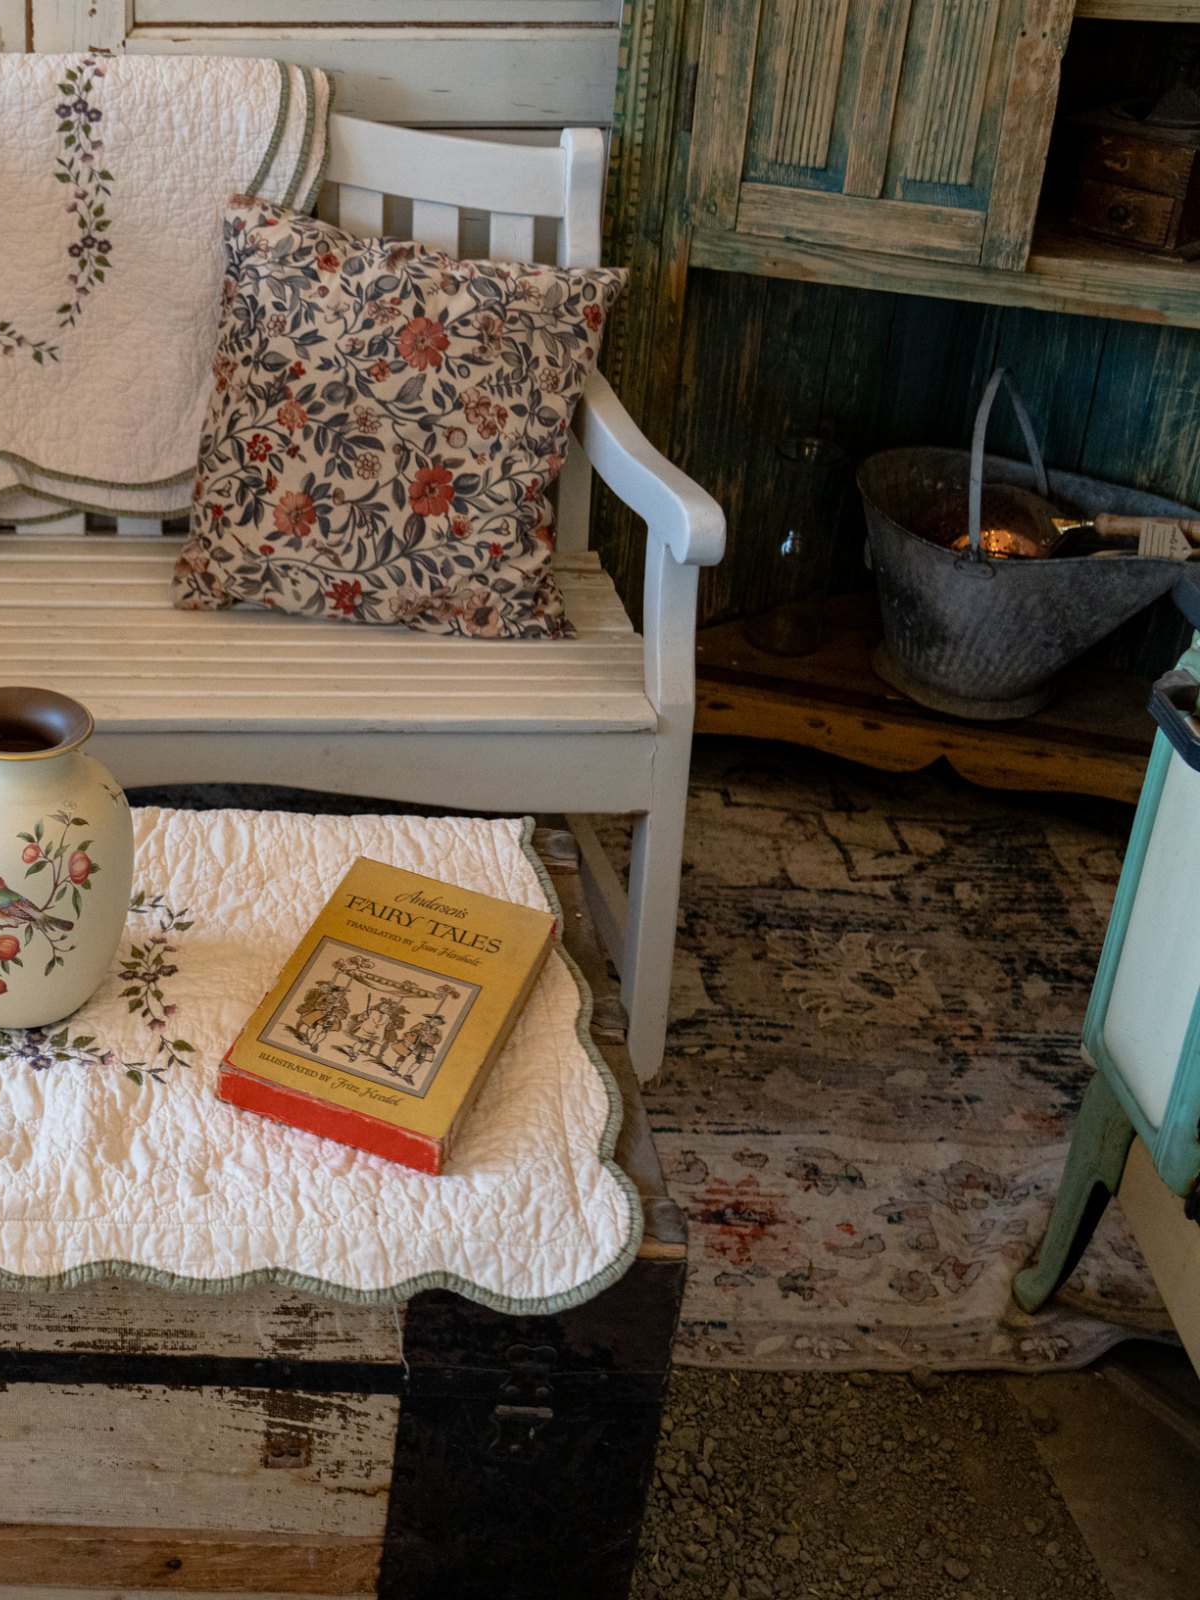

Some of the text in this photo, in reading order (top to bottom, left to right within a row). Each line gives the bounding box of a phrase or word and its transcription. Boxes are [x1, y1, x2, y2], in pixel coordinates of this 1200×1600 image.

[394, 890, 468, 919] Andersen's
[344, 893, 503, 954] FAIRY TALES
[345, 919, 402, 943] TRANSLATED
[402, 937, 414, 946] BY
[258, 1051, 318, 1078] ILLUSTRATED
[318, 1073, 332, 1083] BY
